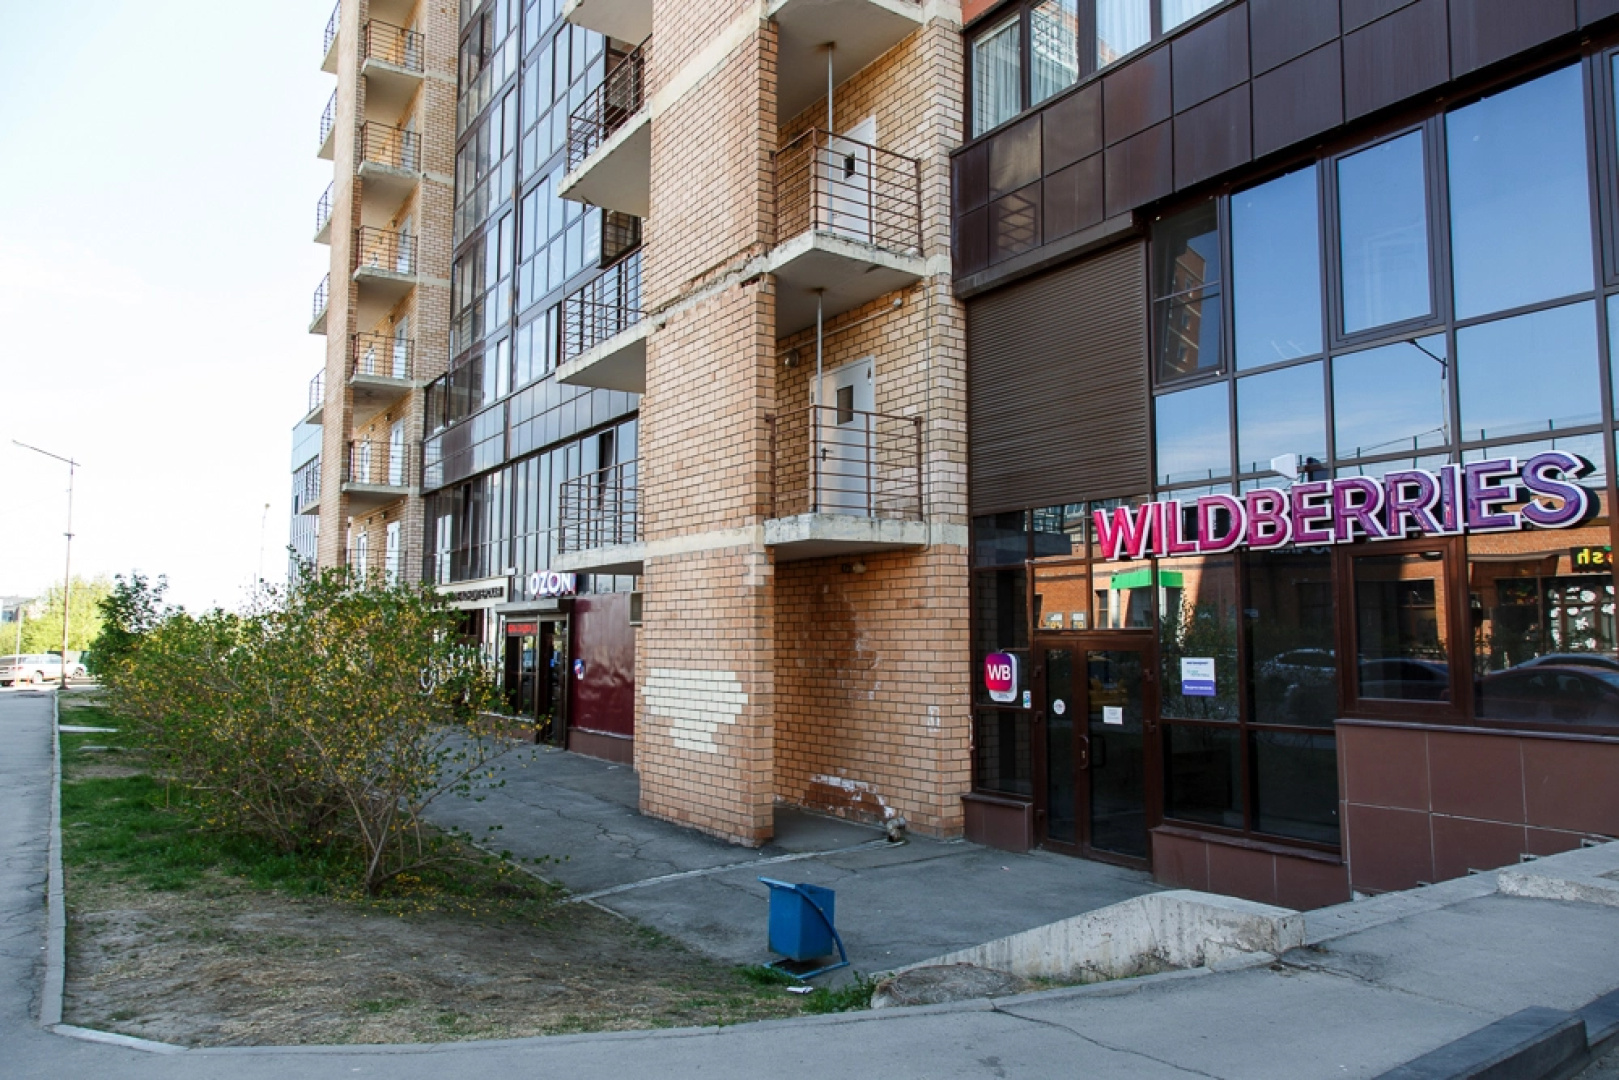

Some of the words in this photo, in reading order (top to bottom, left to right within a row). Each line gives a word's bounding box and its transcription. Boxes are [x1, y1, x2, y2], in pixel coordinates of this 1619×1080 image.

[1092, 449, 1590, 562] WILDBERRIES
[530, 571, 574, 596] OZON
[987, 664, 1011, 681] WB
